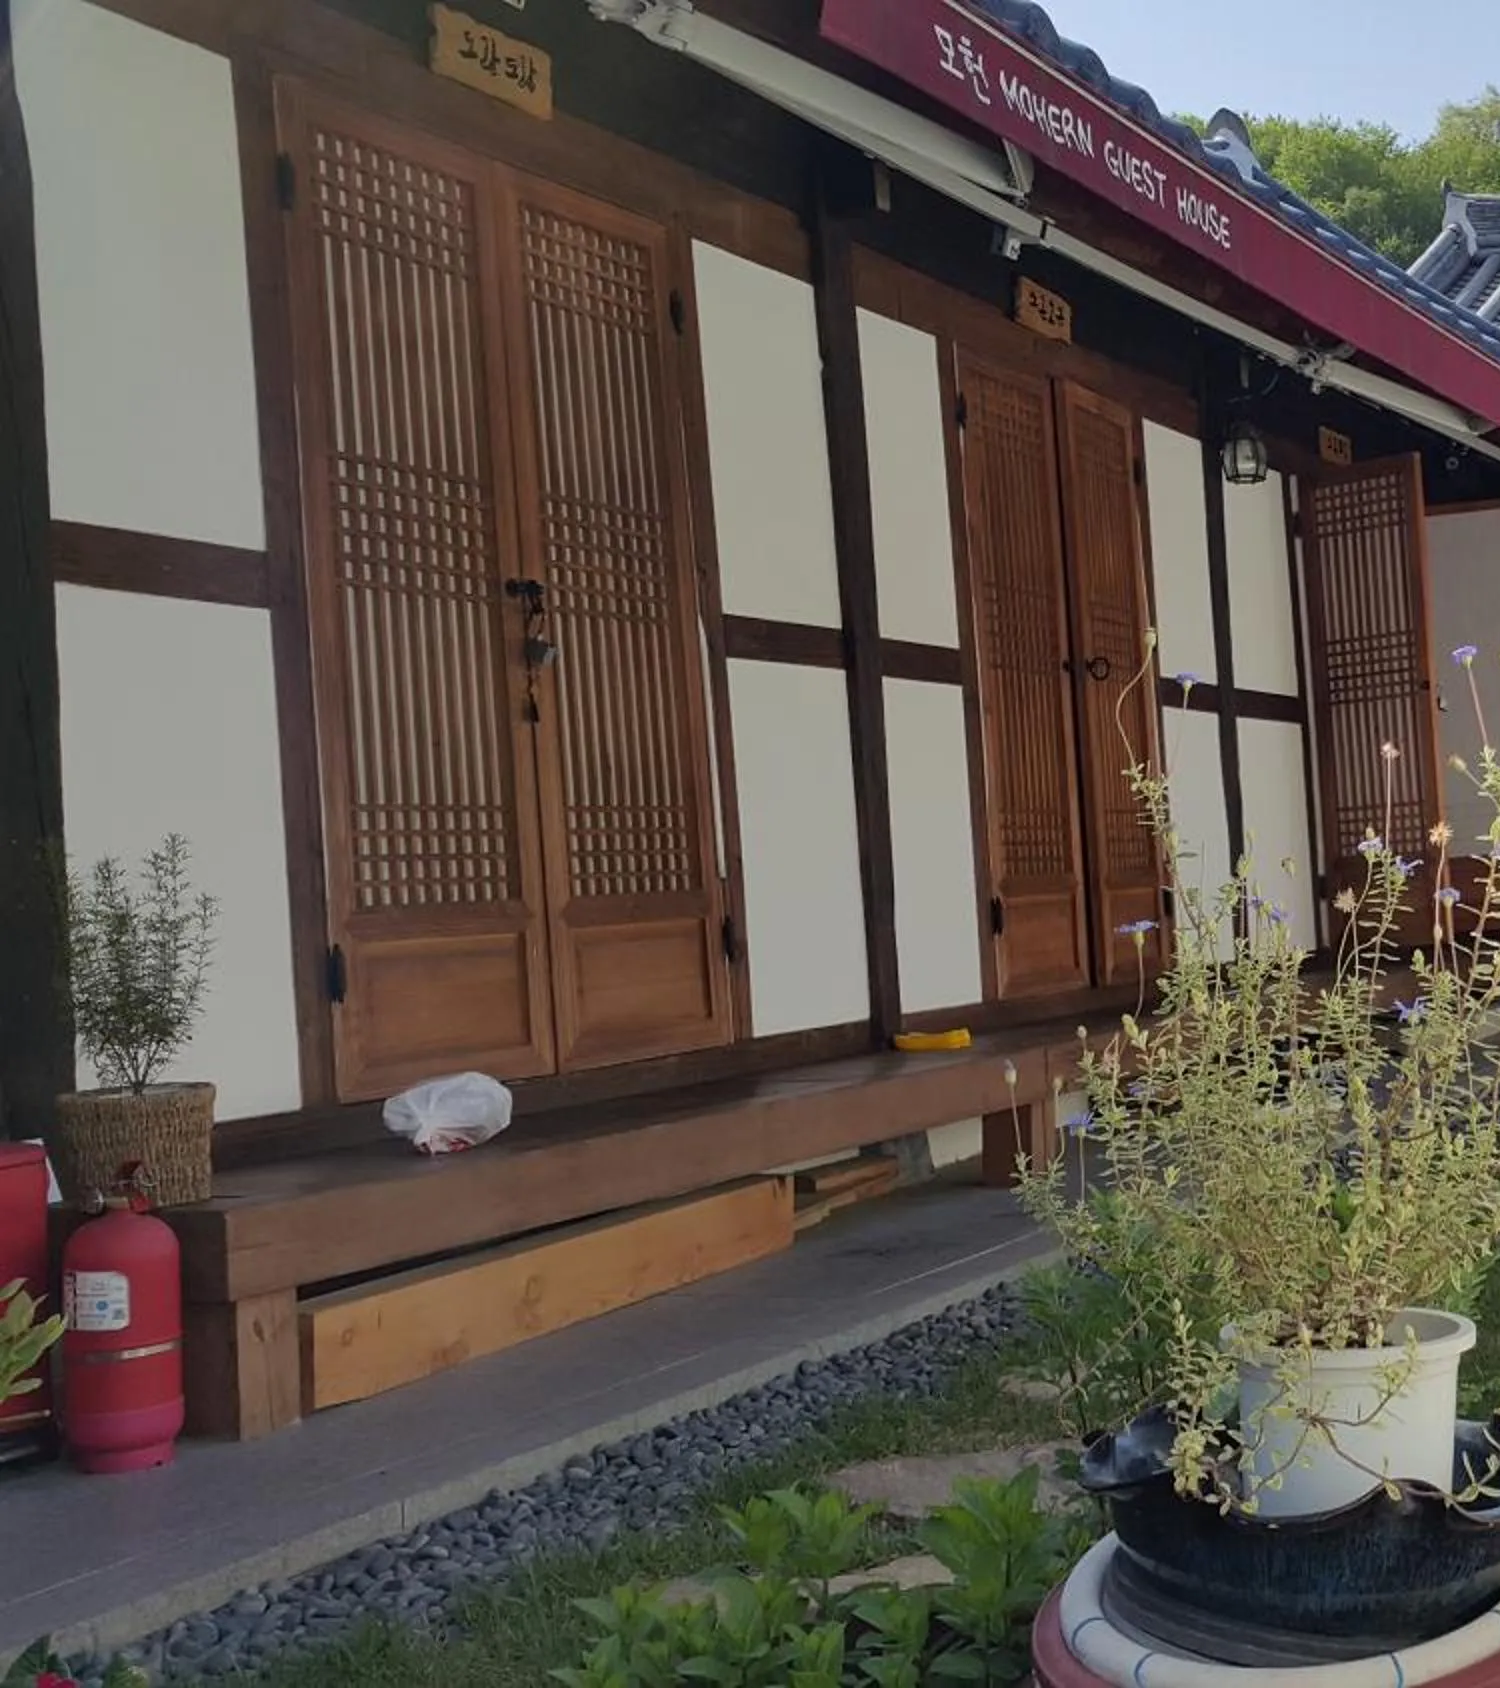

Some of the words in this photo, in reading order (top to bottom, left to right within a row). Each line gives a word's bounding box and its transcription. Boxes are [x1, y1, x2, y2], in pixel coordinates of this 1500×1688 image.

[999, 69, 1095, 158] MOHERN
[1103, 140, 1167, 209] GUEST
[1175, 186, 1231, 249] HOUSE
